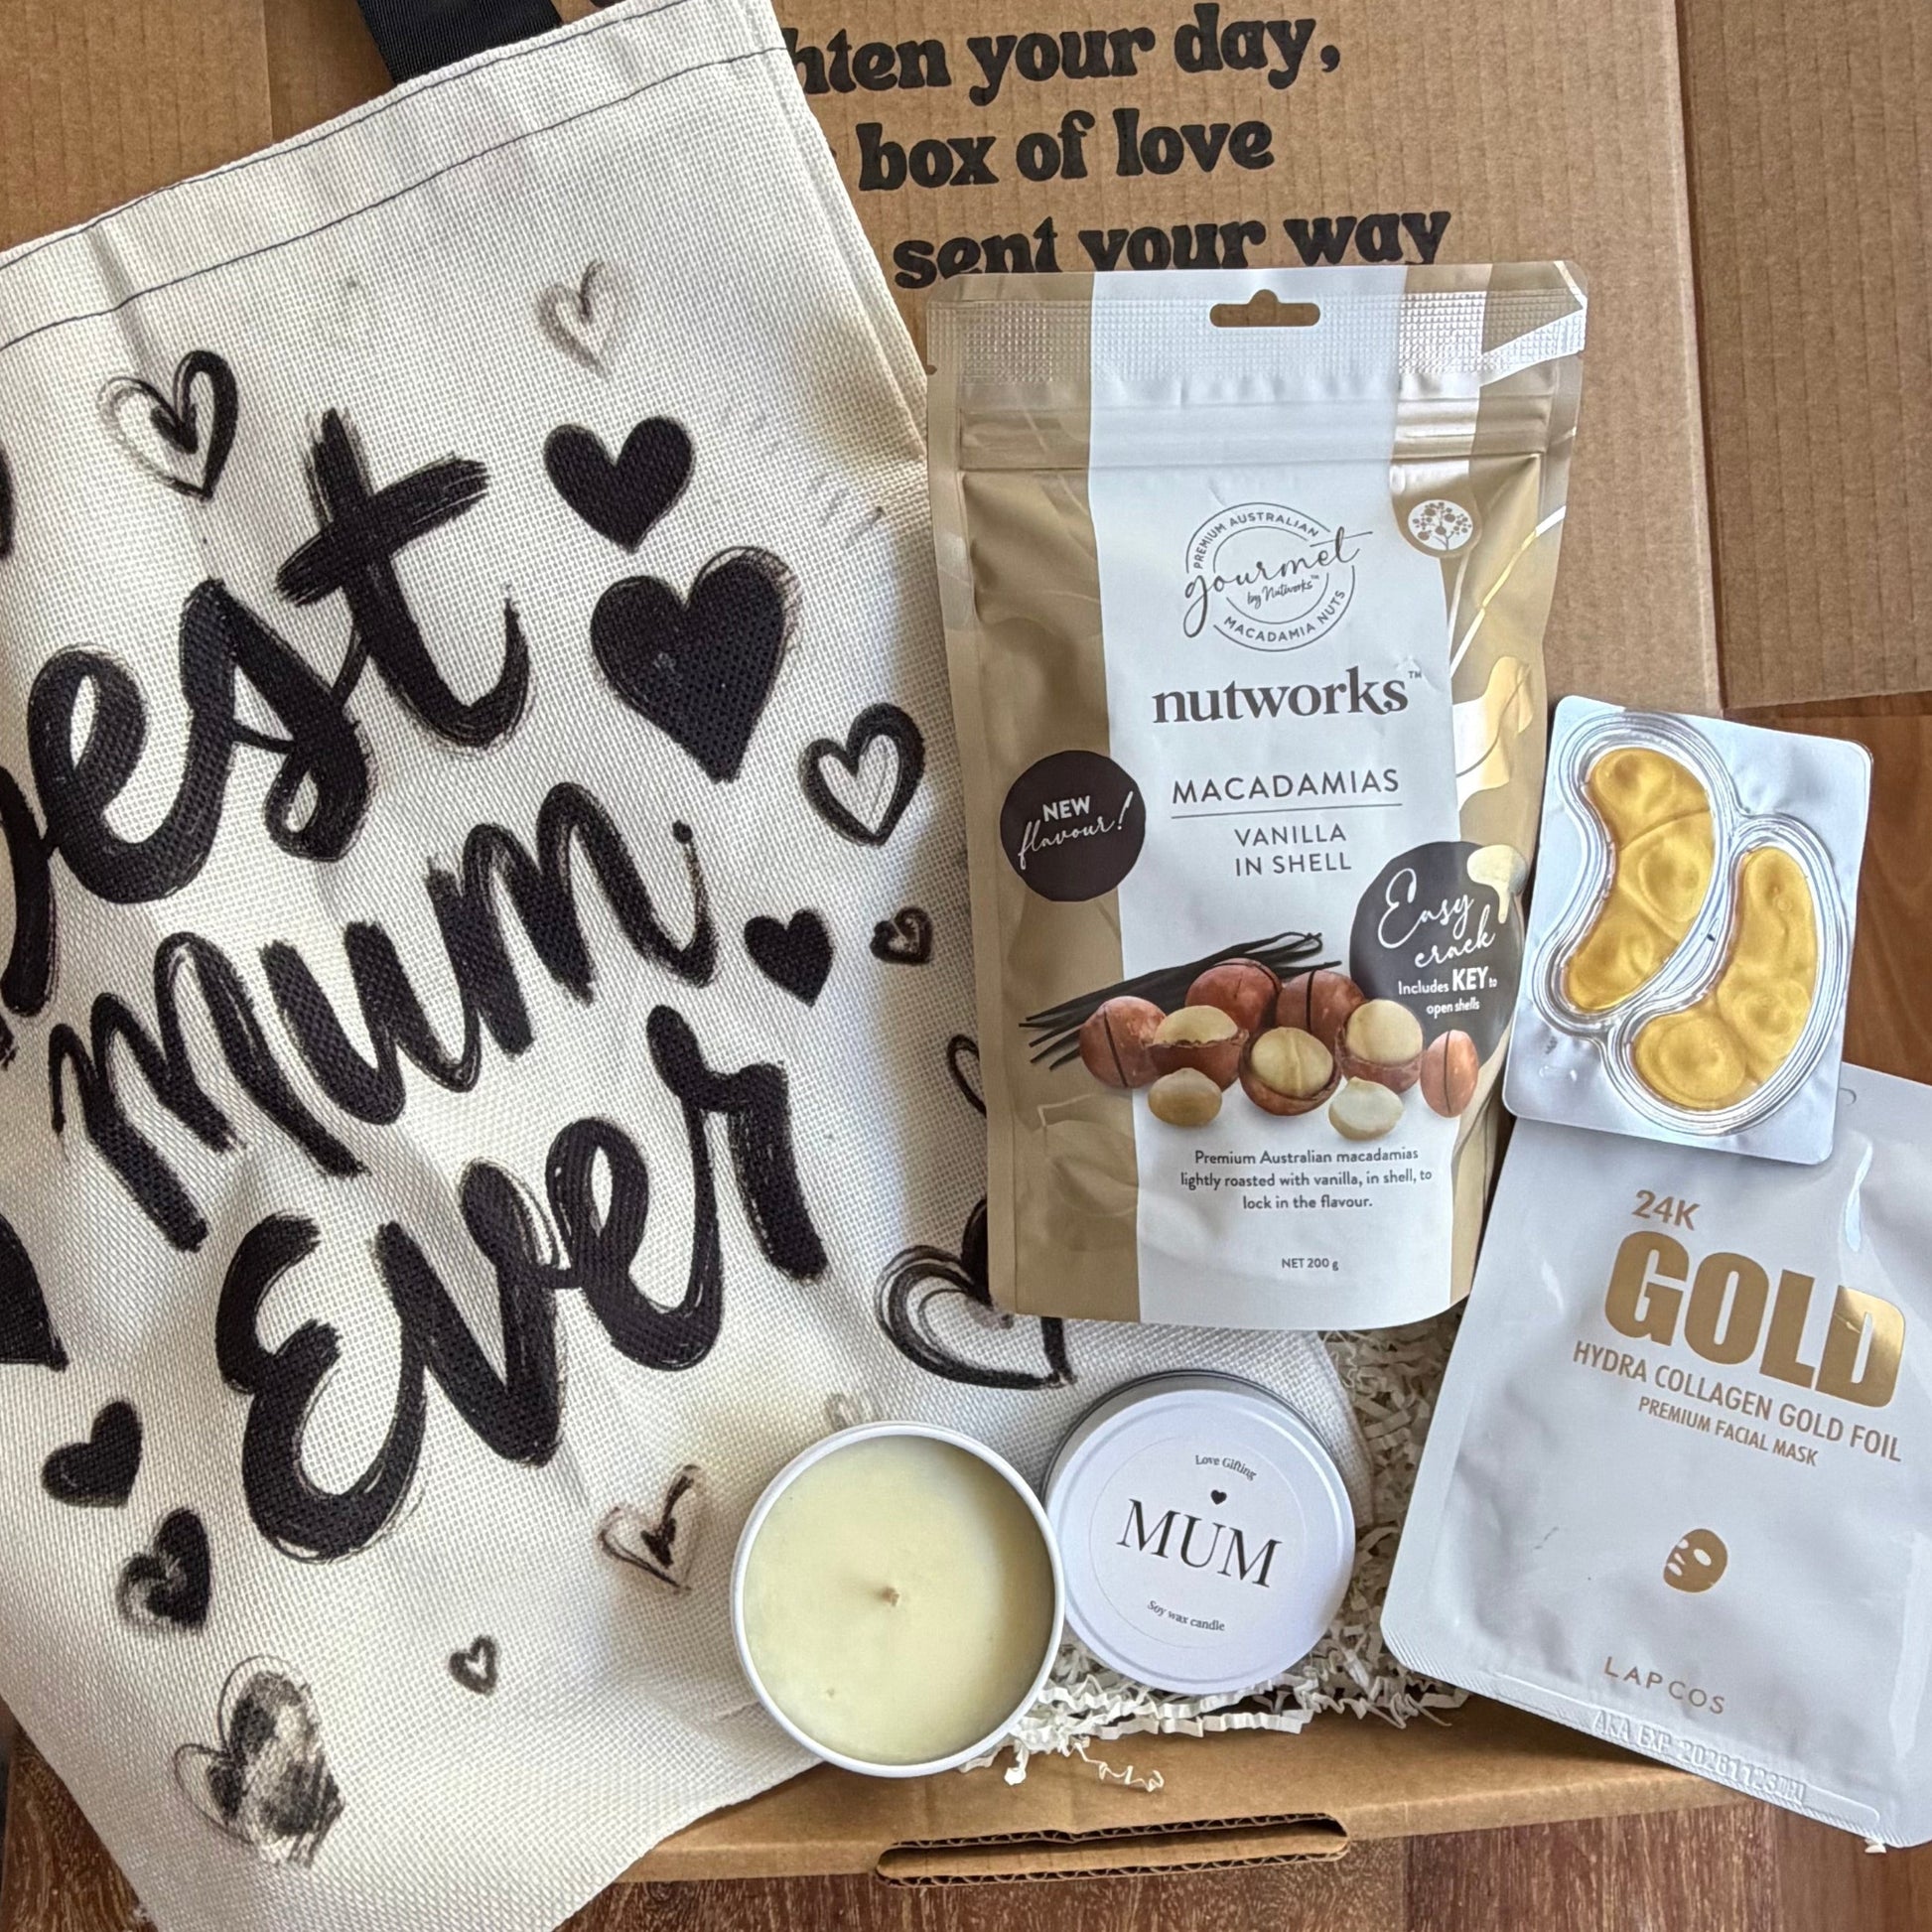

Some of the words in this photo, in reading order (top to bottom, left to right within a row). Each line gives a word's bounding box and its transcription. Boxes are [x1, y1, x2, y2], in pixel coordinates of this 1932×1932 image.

[968, 23, 1155, 106] your
[1173, 2, 1340, 90] day,
[857, 122, 999, 192] box
[1016, 109, 1095, 181] of
[1112, 107, 1275, 177] love
[894, 216, 1062, 289] sent
[1283, 211, 1451, 266] way
[1192, 522, 1227, 570] PREMIUM
[1229, 511, 1319, 538] AUSTRALIAN
[1183, 526, 1374, 638] gourmet
[1246, 590, 1261, 610] by
[1223, 616, 1316, 643] MACADAMIA
[1317, 590, 1346, 625] NUTS
[1042, 795, 1091, 822] NEW
[1172, 768, 1400, 804] MACADAMIAS
[1019, 791, 1134, 870] flavour!
[1234, 823, 1347, 847] VANILLA
[1235, 857, 1264, 877] IN
[1272, 852, 1352, 876] SHELL
[1377, 868, 1474, 949] Easy
[1414, 903, 1496, 968] crack
[1398, 979, 1449, 995] Includes
[1452, 966, 1489, 991] KEY
[1489, 977, 1498, 989] to
[49, 780, 718, 1253] mum
[1426, 1001, 1453, 1019] open
[1454, 997, 1480, 1012] shells
[1180, 1172, 1221, 1191] lightly
[1224, 1172, 1276, 1187] roasted
[1280, 1172, 1311, 1186] with
[1313, 1171, 1363, 1187] vanilla,
[1366, 1171, 1380, 1184] in
[1383, 1169, 1417, 1184] shell,
[1420, 1169, 1432, 1180] to
[1194, 1150, 1256, 1165] Premium
[1259, 1149, 1332, 1165] Australian
[1336, 1147, 1419, 1163] macadamias
[1243, 1195, 1272, 1209] lock
[1276, 1194, 1289, 1208] in
[1293, 1194, 1316, 1208] the
[1320, 1193, 1373, 1208] flavour.
[1632, 1189, 1701, 1231] 24K
[216, 1004, 829, 1563] Ever
[1282, 1258, 1304, 1269] NET
[1307, 1257, 1329, 1269] 200
[1332, 1260, 1339, 1271] g
[1604, 1230, 1906, 1408] GOLD
[1573, 1339, 1648, 1382] HYDRA
[1654, 1364, 1773, 1421] COLLAGEN
[1779, 1402, 1844, 1443] GOLD
[1851, 1424, 1902, 1462] FOIL
[1637, 1396, 1712, 1433] PREMIUM
[1715, 1423, 1768, 1451] FACIAL
[1773, 1439, 1819, 1466] MASK
[1194, 1454, 1220, 1466] Love
[1222, 1456, 1257, 1480] Gifting
[1116, 1498, 1283, 1588] MUM
[1148, 1599, 1166, 1616] Soy
[1168, 1611, 1188, 1624] wax
[1190, 1616, 1225, 1631] candle
[1602, 1656, 1725, 1715] LAPCOS
[1638, 1724, 1673, 1753] EXP
